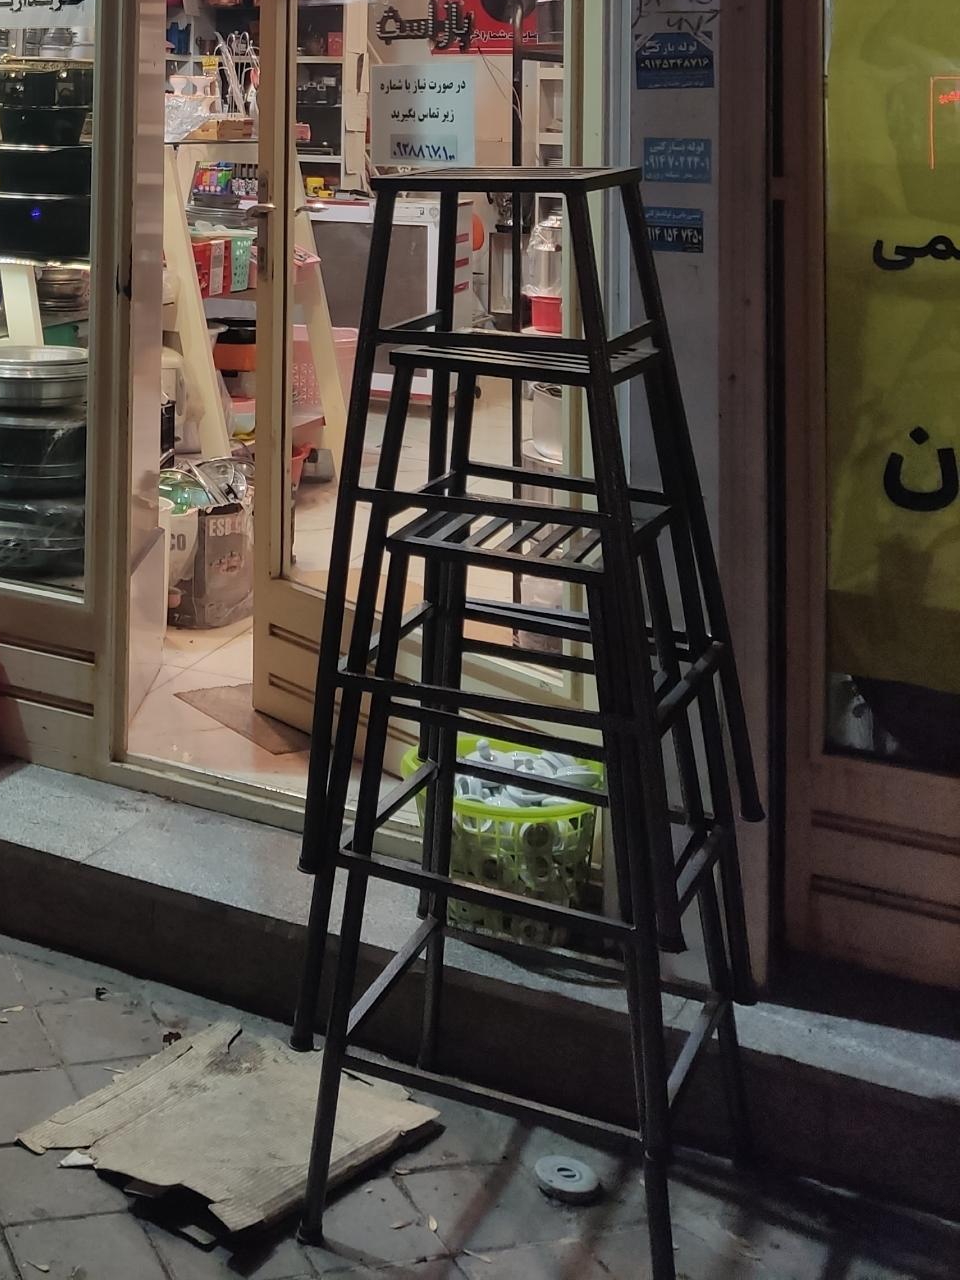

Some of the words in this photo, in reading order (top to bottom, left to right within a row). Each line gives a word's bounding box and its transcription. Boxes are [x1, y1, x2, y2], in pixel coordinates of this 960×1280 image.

[380, 79, 403, 94] شماره
[404, 79, 412, 93] با
[412, 79, 427, 94] نیاز
[428, 80, 454, 94] صورت
[455, 79, 466, 94] در
[391, 107, 416, 123] بگیرید
[418, 107, 441, 122] تماس
[442, 108, 455, 123] زیر
